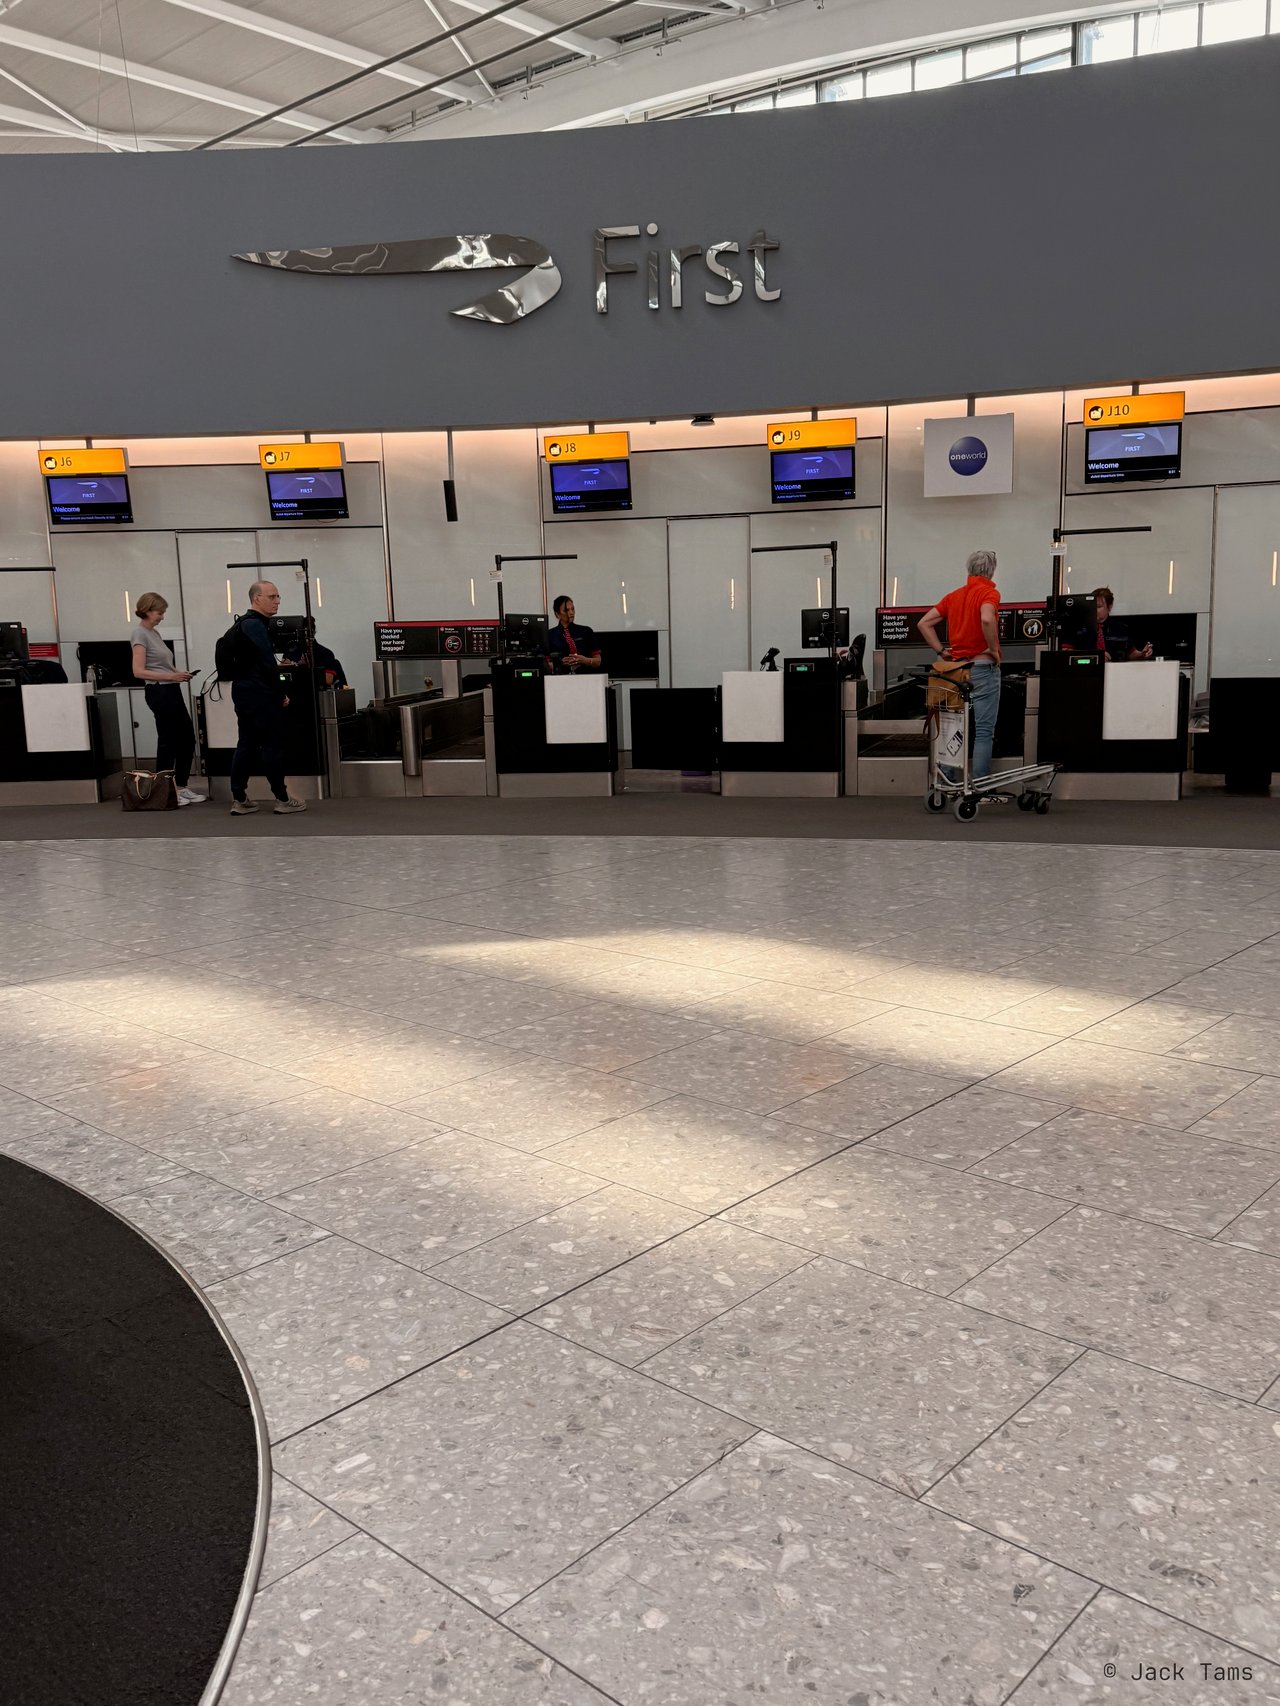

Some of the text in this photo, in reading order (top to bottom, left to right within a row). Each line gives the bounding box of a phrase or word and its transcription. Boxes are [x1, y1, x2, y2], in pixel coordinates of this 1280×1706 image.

[594, 222, 781, 313] First
[1108, 404, 1130, 417] J10
[788, 430, 801, 441] J9
[564, 442, 577, 453] J8
[60, 456, 72, 467] J6
[280, 451, 290, 462] J7
[950, 452, 986, 461] oneworld
[1088, 462, 1119, 470] Welcome
[774, 483, 802, 491] Welcome
